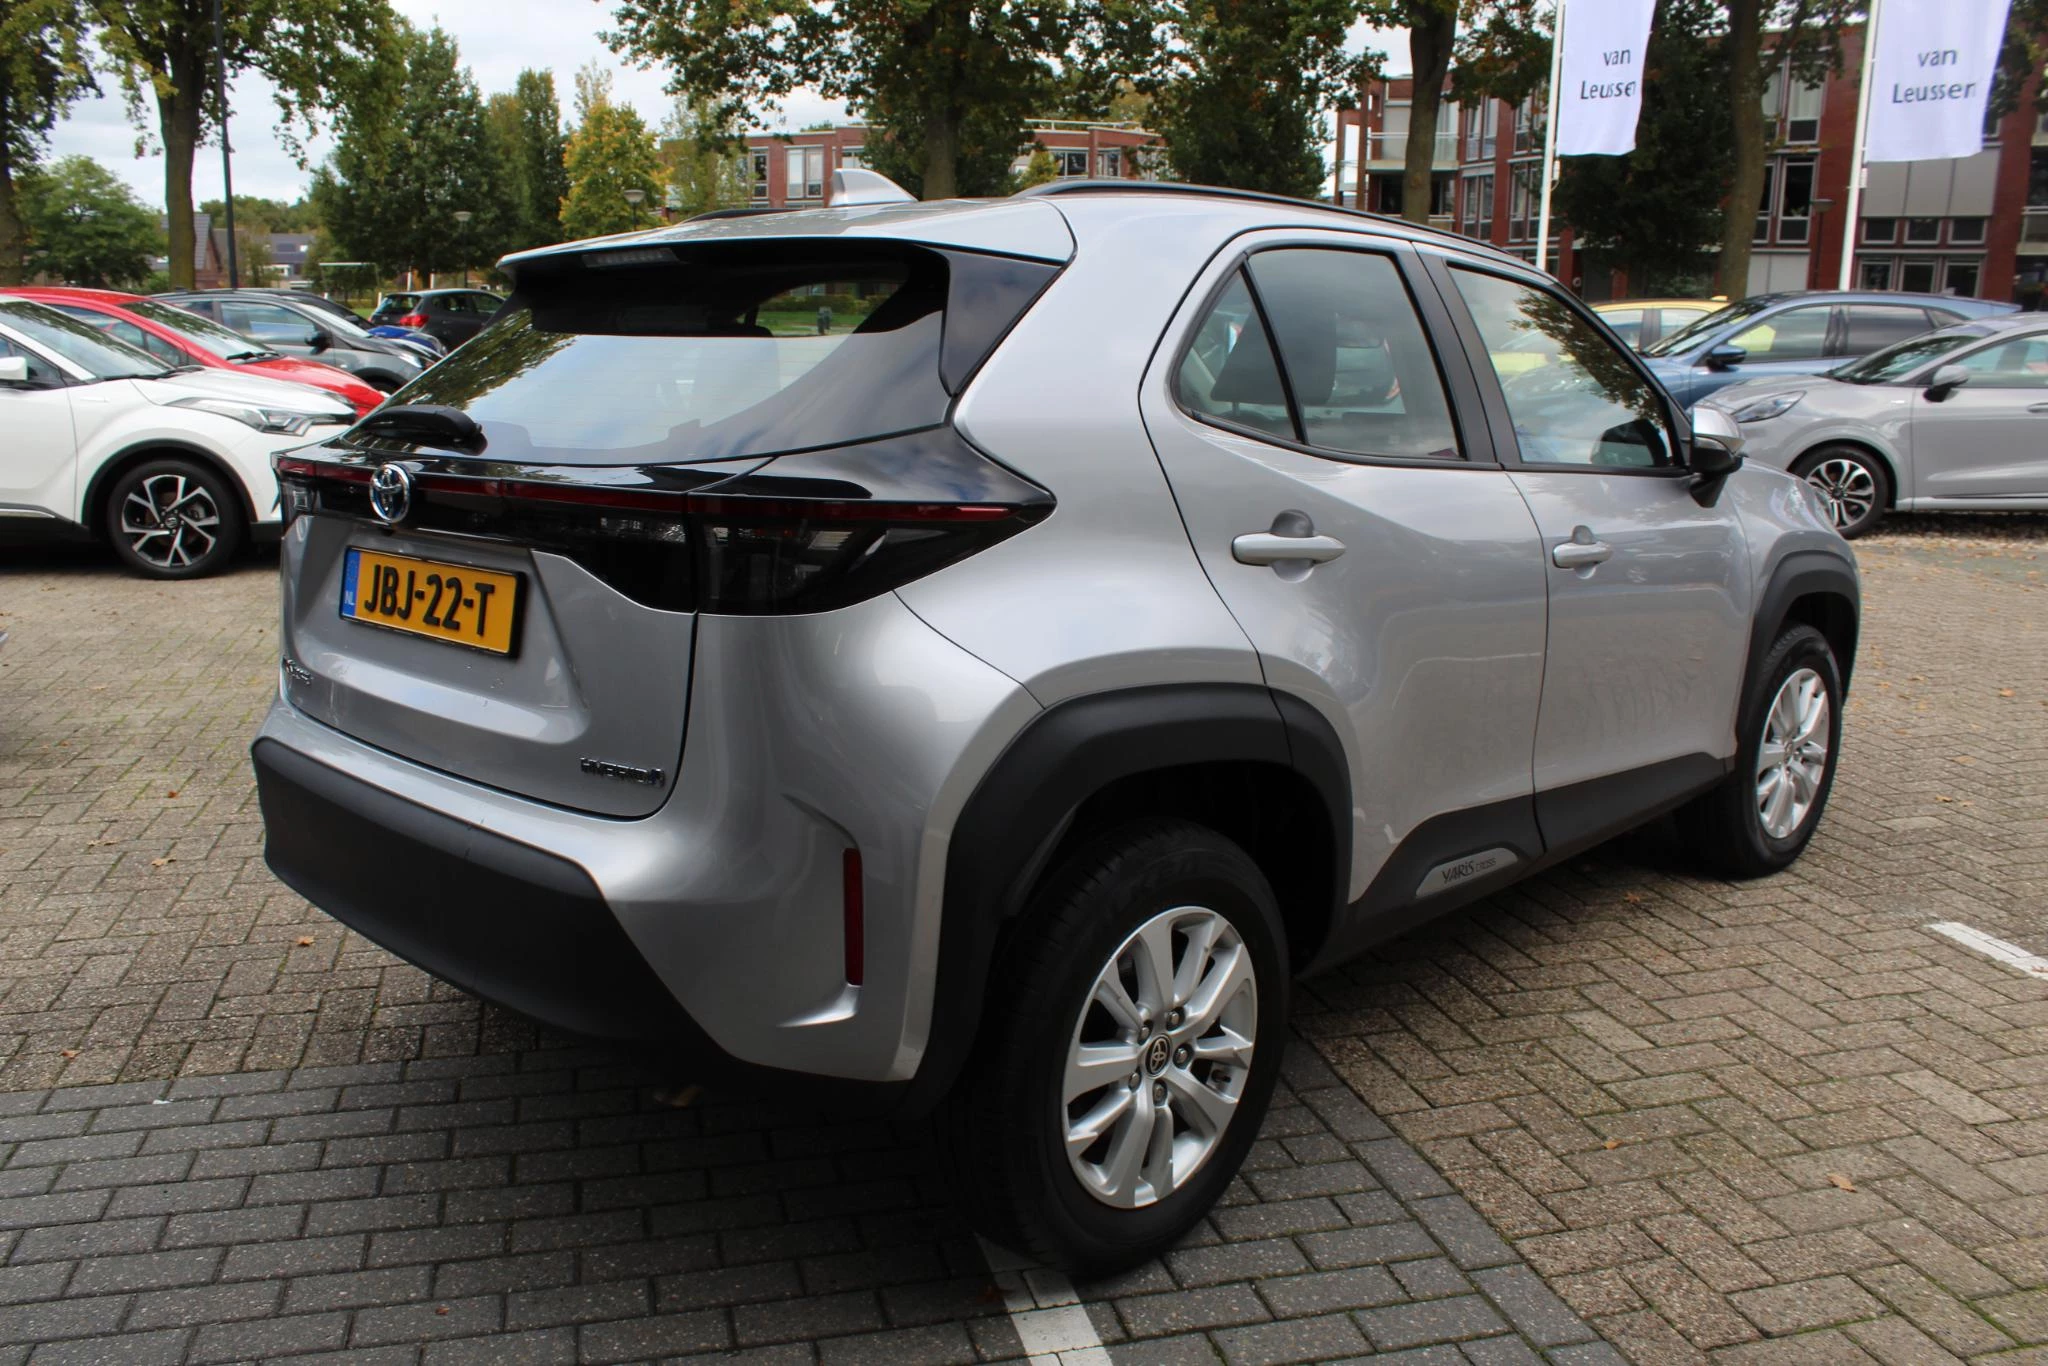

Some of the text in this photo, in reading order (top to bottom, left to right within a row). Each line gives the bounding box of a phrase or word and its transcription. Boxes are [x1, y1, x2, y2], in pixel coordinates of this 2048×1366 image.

[1603, 49, 1631, 66] van
[1918, 49, 1957, 67] van
[364, 564, 496, 637] JBJ-22-T
